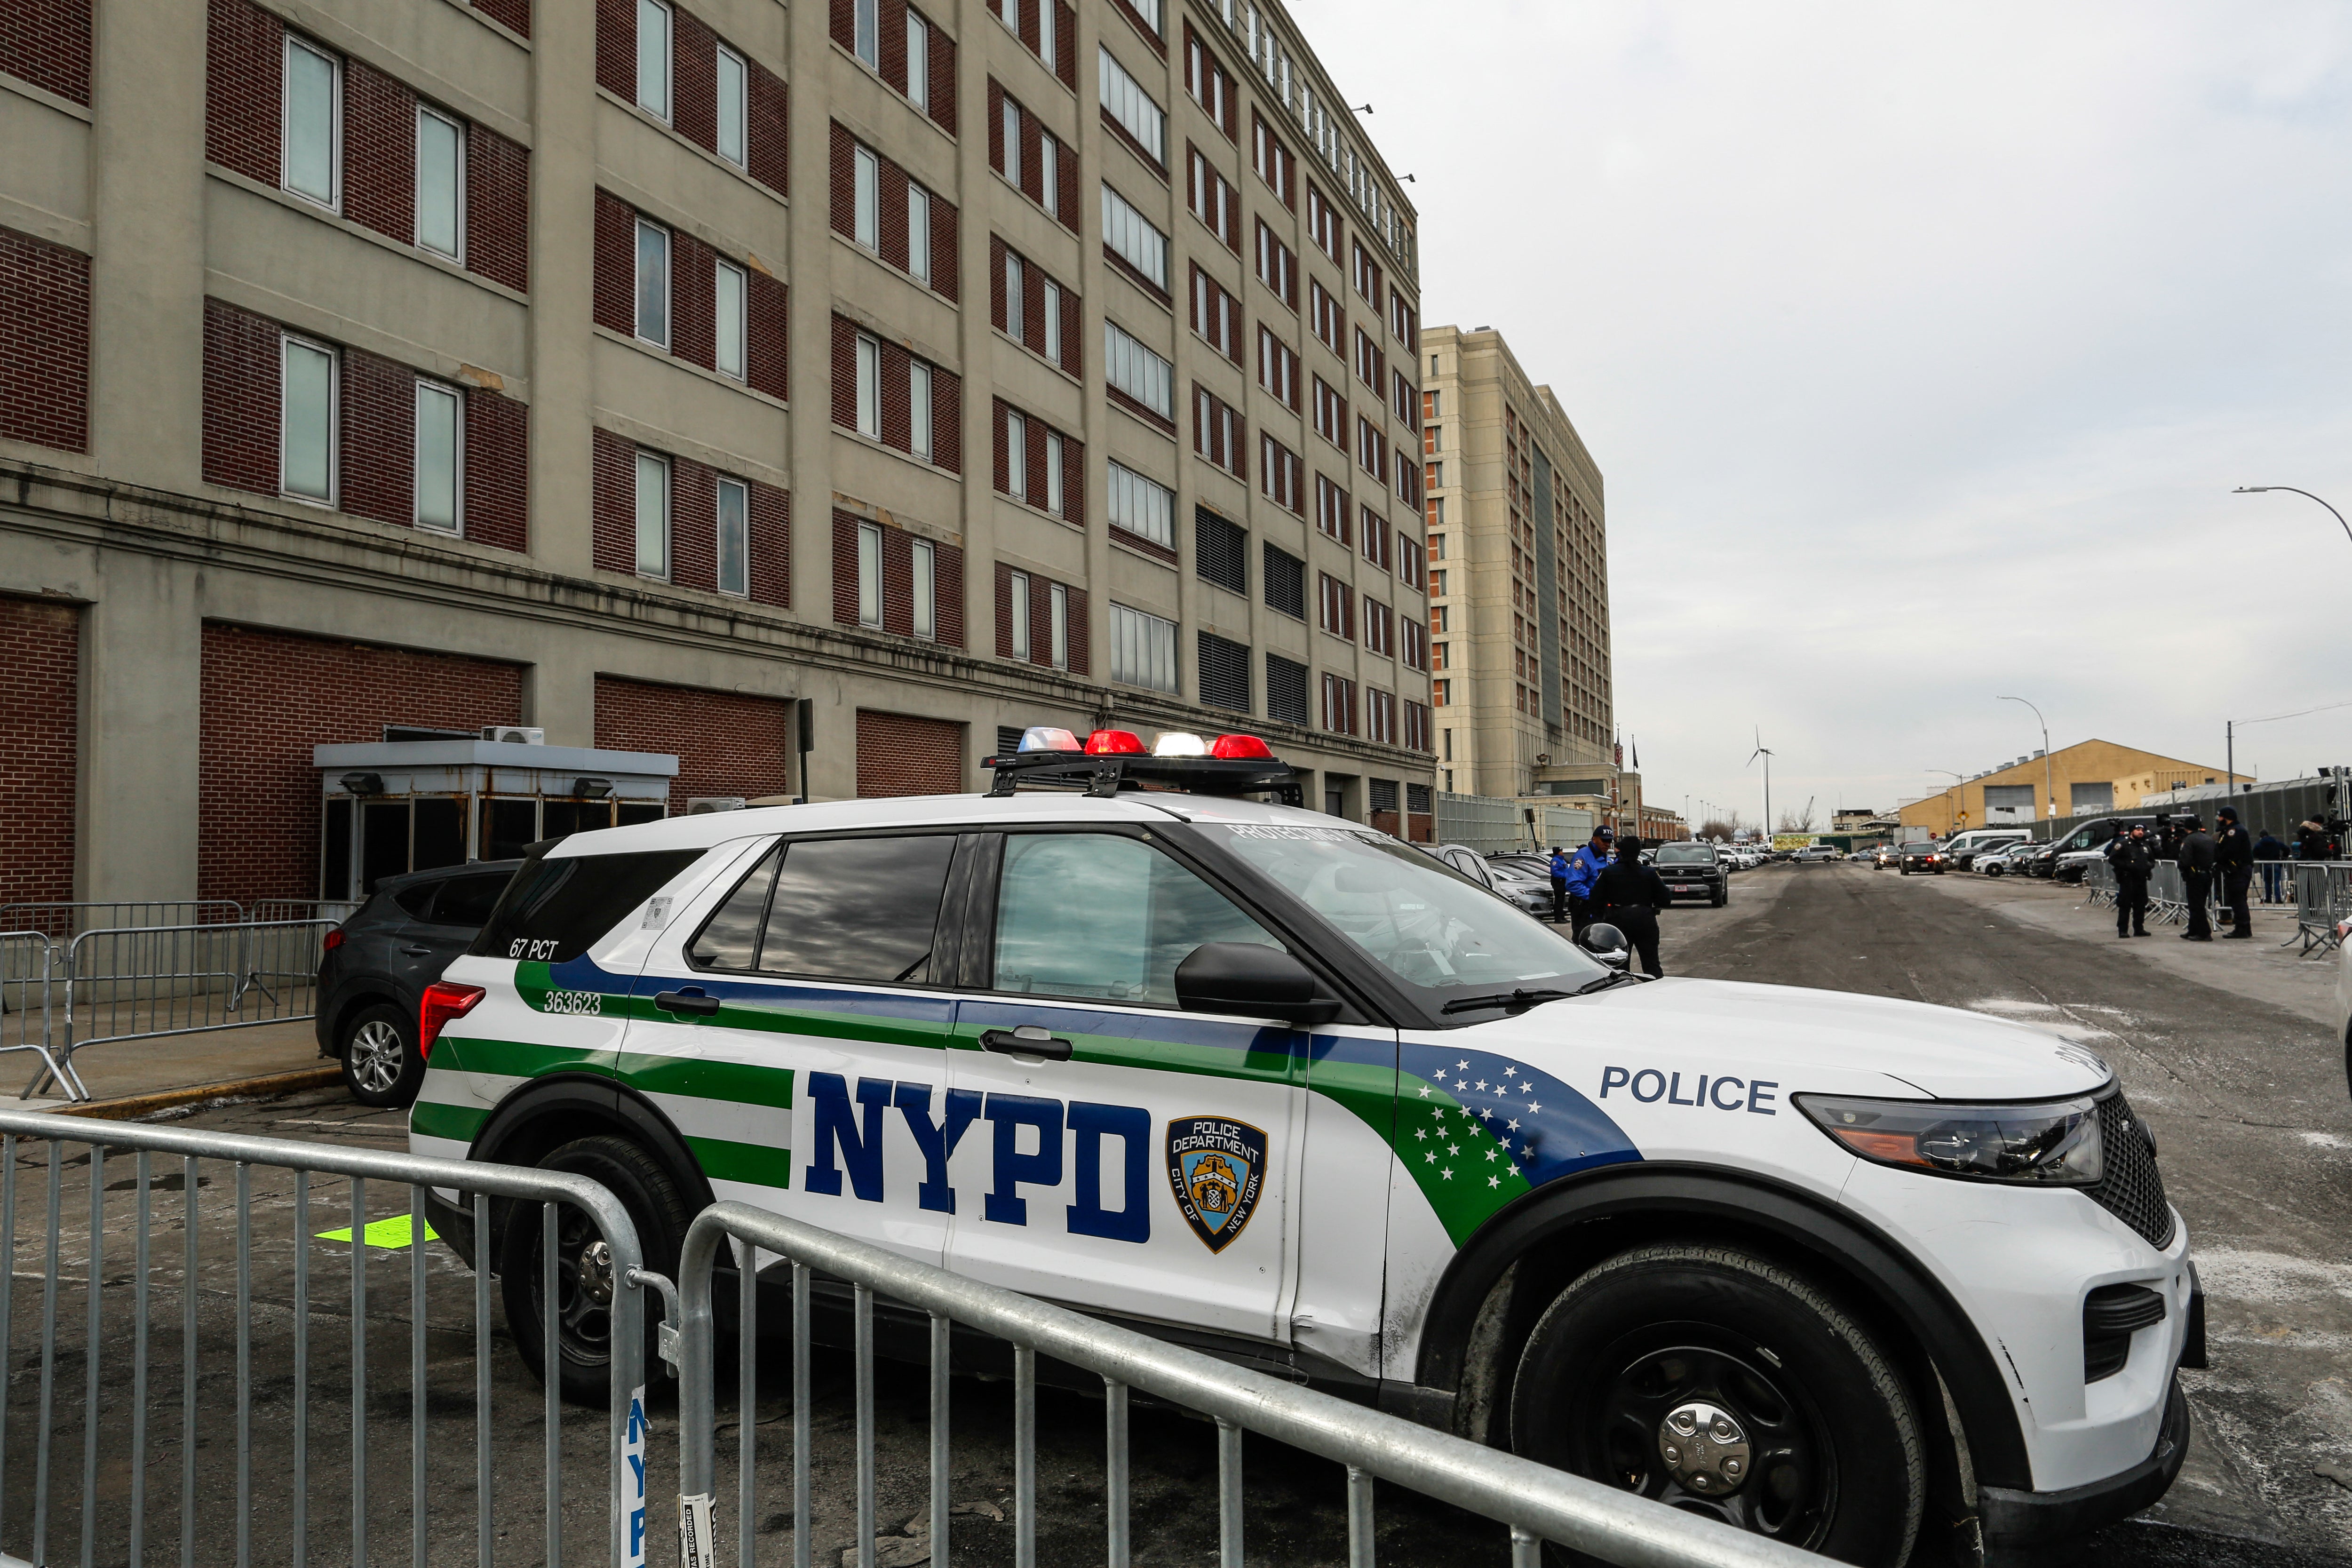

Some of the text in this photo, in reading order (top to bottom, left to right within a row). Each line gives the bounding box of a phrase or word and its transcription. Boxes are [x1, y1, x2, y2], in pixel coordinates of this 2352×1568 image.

[1223, 824, 1343, 842] PROTECTING
[509, 938, 559, 959] 67 PCT
[544, 991, 601, 1015] 363623
[1599, 1066, 1779, 1115] POLICE
[1173, 1135, 1259, 1163] DEPARTMENT
[1193, 1122, 1240, 1139] POLICE
[804, 1071, 1151, 1243] NYPD
[1172, 1168, 1199, 1221] CITY OF
[1227, 1173, 1259, 1233] NEW YORK
[628, 1398, 645, 1568] NYP
[686, 1509, 696, 1553] RECORDED
